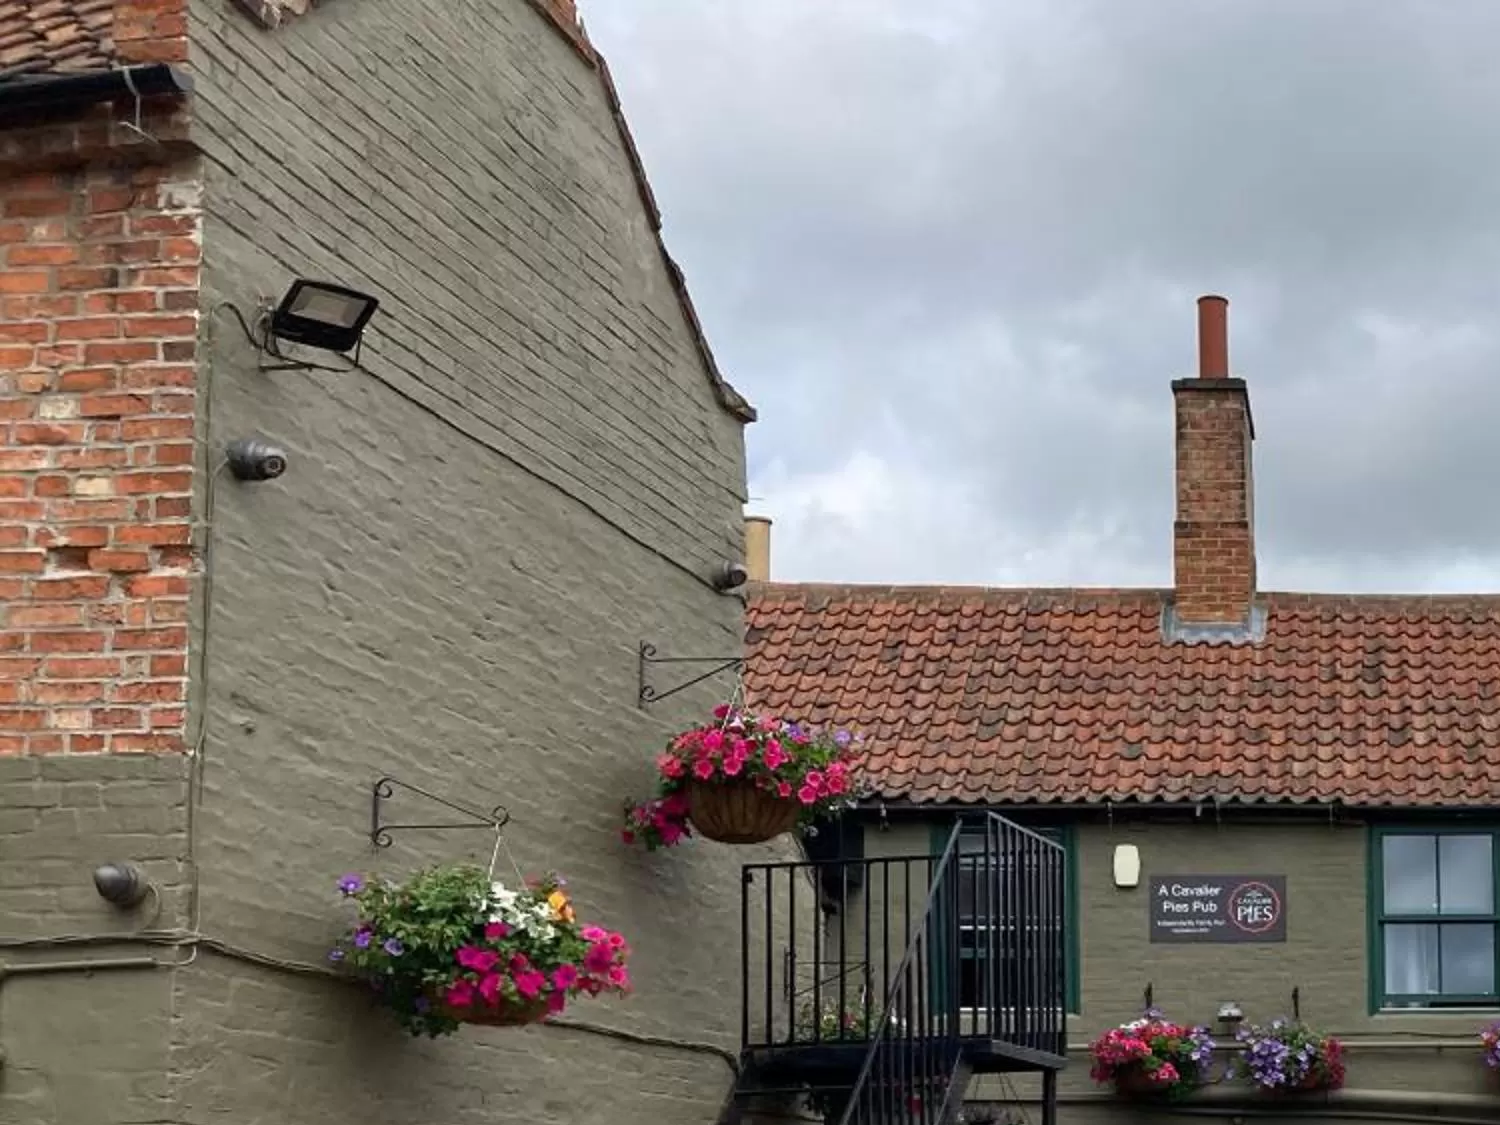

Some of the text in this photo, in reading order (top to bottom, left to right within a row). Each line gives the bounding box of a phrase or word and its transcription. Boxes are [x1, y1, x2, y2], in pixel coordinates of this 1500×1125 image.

[1158, 884, 1222, 897] A Cavalier
[1163, 901, 1218, 913] Pies Pub
[1237, 905, 1273, 923] PIES
